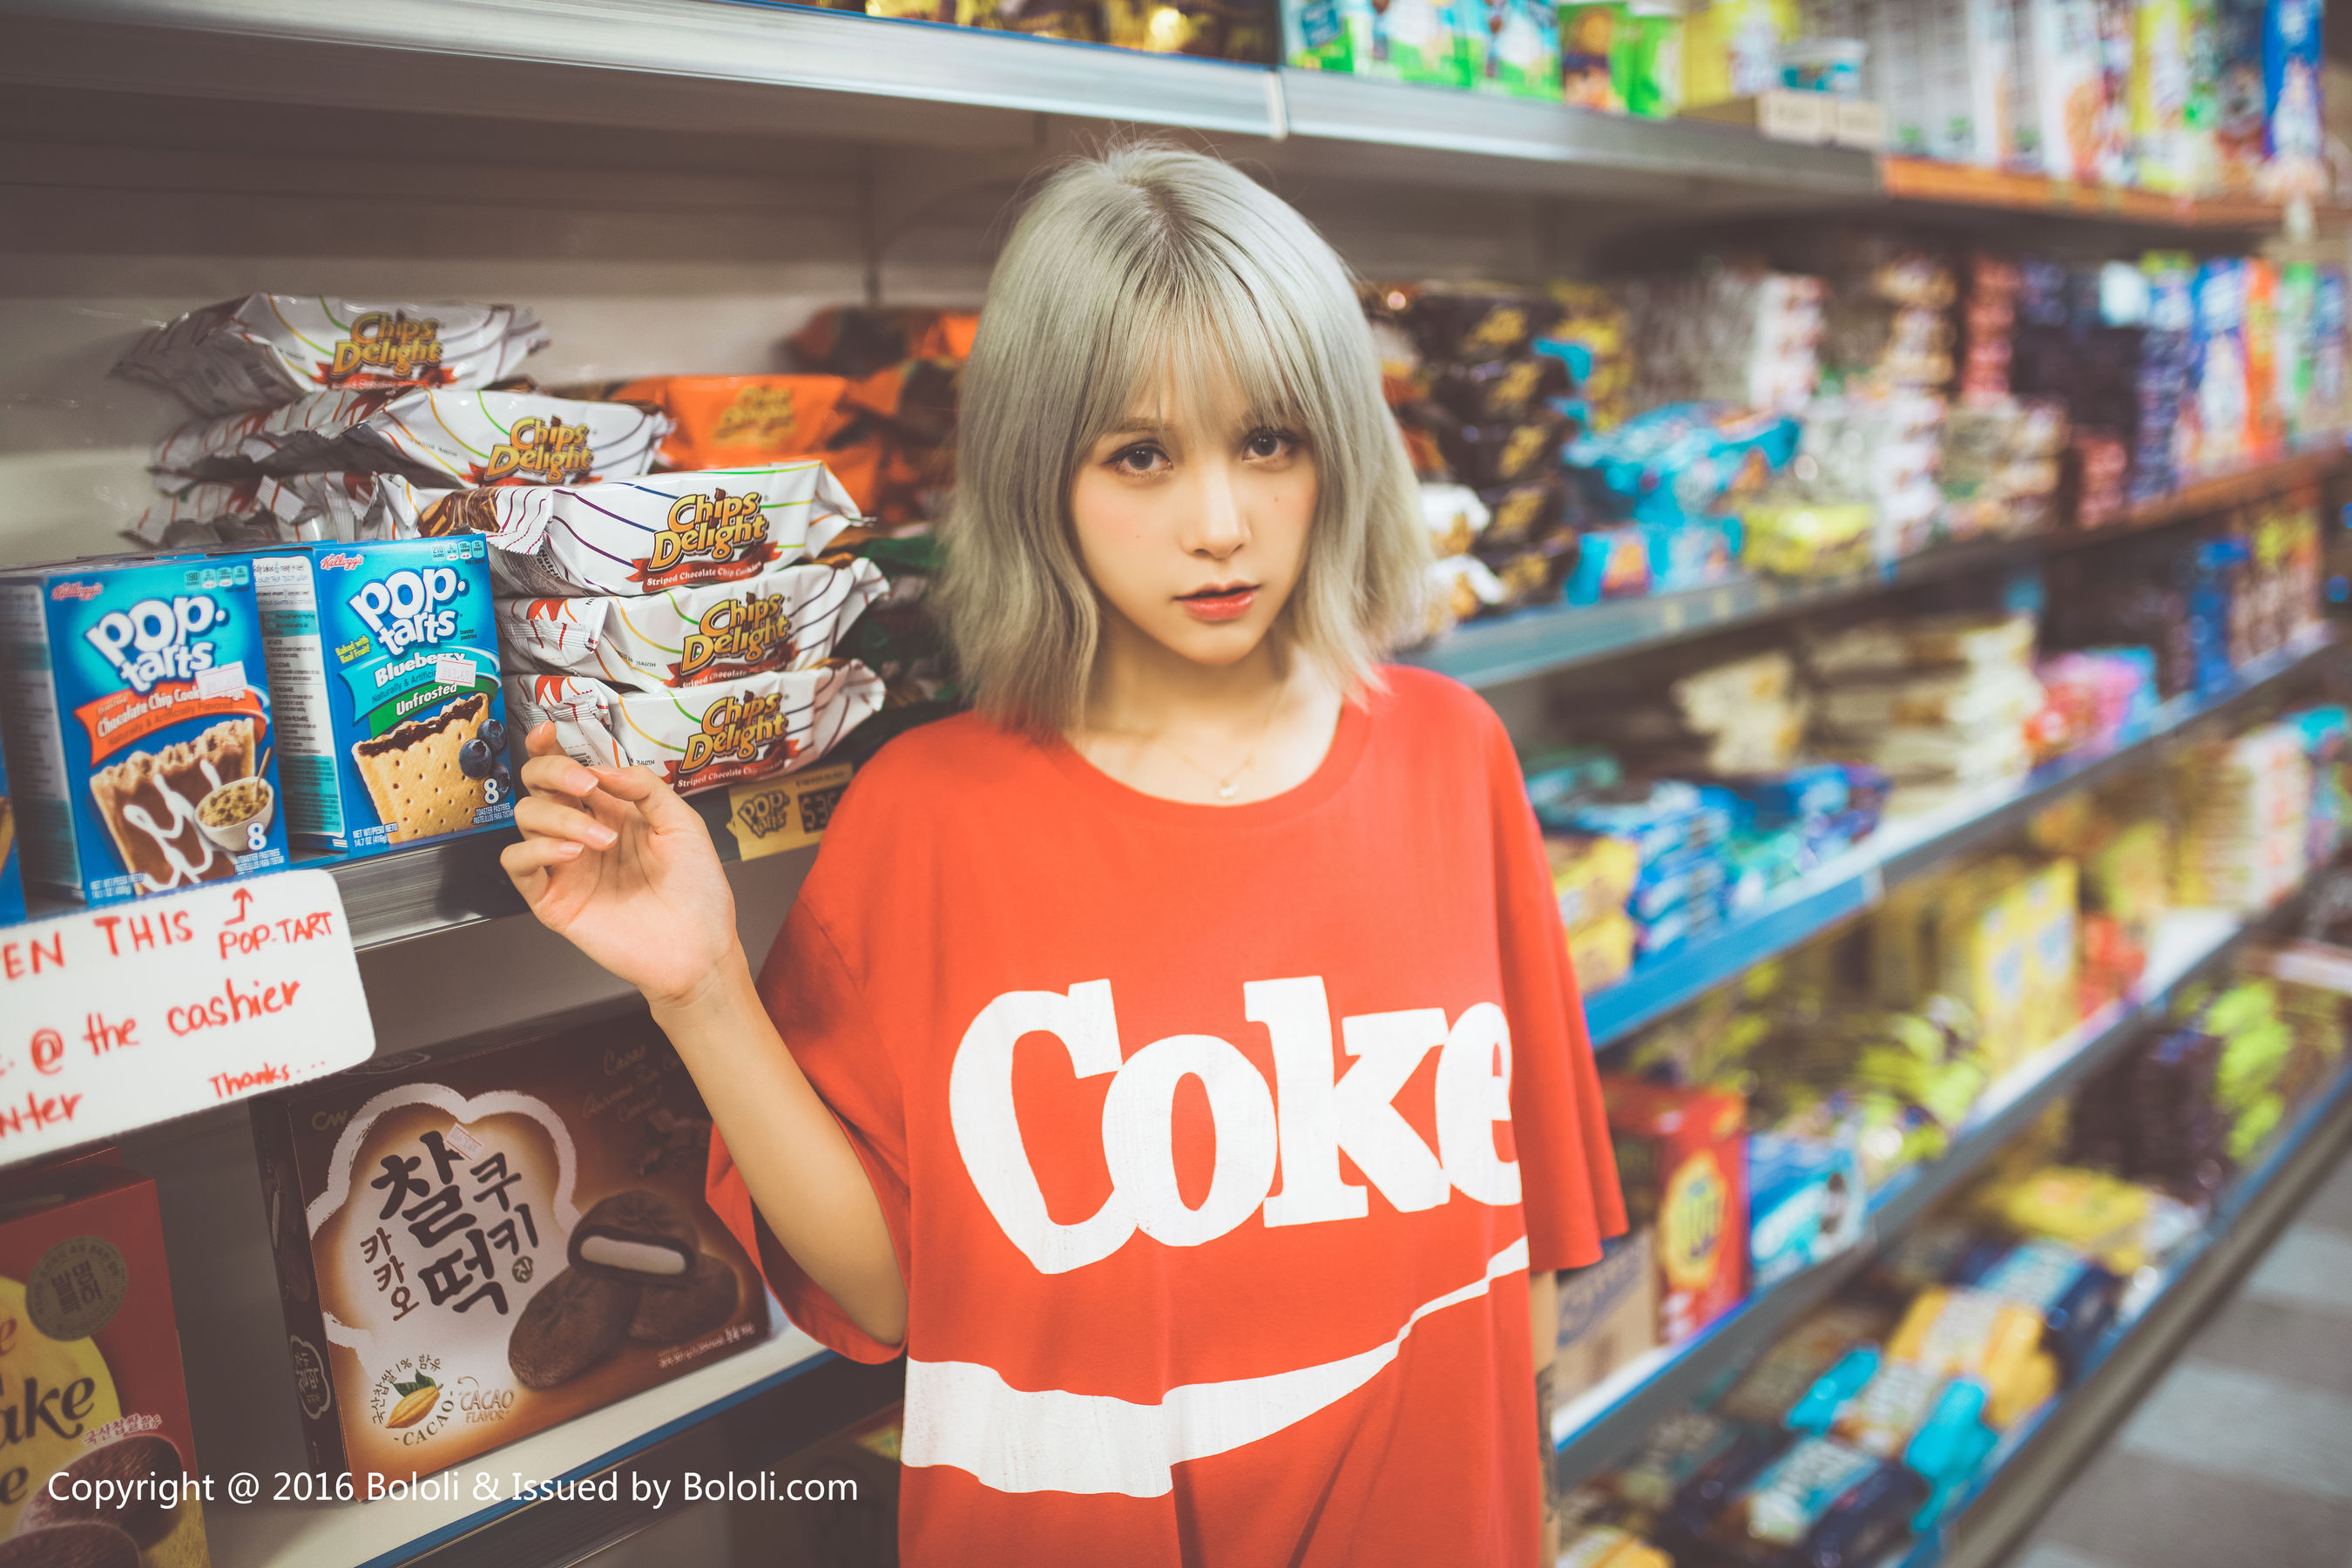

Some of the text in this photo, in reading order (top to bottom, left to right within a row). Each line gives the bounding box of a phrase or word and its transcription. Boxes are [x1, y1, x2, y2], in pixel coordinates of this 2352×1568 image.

[350, 308, 438, 345] Chips
[331, 340, 443, 378] Delight
[510, 415, 590, 451] Chips
[484, 443, 594, 484] Delight
[667, 488, 761, 533] Chips
[321, 554, 364, 571] Kellogg's
[648, 514, 769, 572] Delight
[51, 582, 104, 601] Kellogg's
[646, 574, 679, 587] Striped
[679, 568, 717, 581] Chocolate
[717, 566, 734, 577] Chip
[378, 610, 456, 656] tarts
[700, 592, 785, 638] Chips
[120, 641, 216, 694] tarts
[680, 615, 791, 677] Delight
[97, 702, 148, 738] Chocolate
[147, 692, 173, 711] Chip
[371, 682, 402, 704] Naturally
[395, 682, 458, 716] Unfrosted
[700, 691, 787, 736] Chips
[679, 712, 789, 774] Delight
[483, 778, 500, 804] 8
[677, 776, 706, 787] Striped
[707, 768, 742, 781] Chocolate
[247, 821, 267, 850] 8
[93, 910, 193, 957] THIS
[218, 910, 333, 961] POP-TART
[30, 1029, 64, 1076] @
[83, 1011, 139, 1057] the
[167, 977, 301, 1037] cashier
[950, 975, 1522, 1274] Coke
[470, 1151, 539, 1256] 쿠키
[360, 1226, 420, 1322] 카카오
